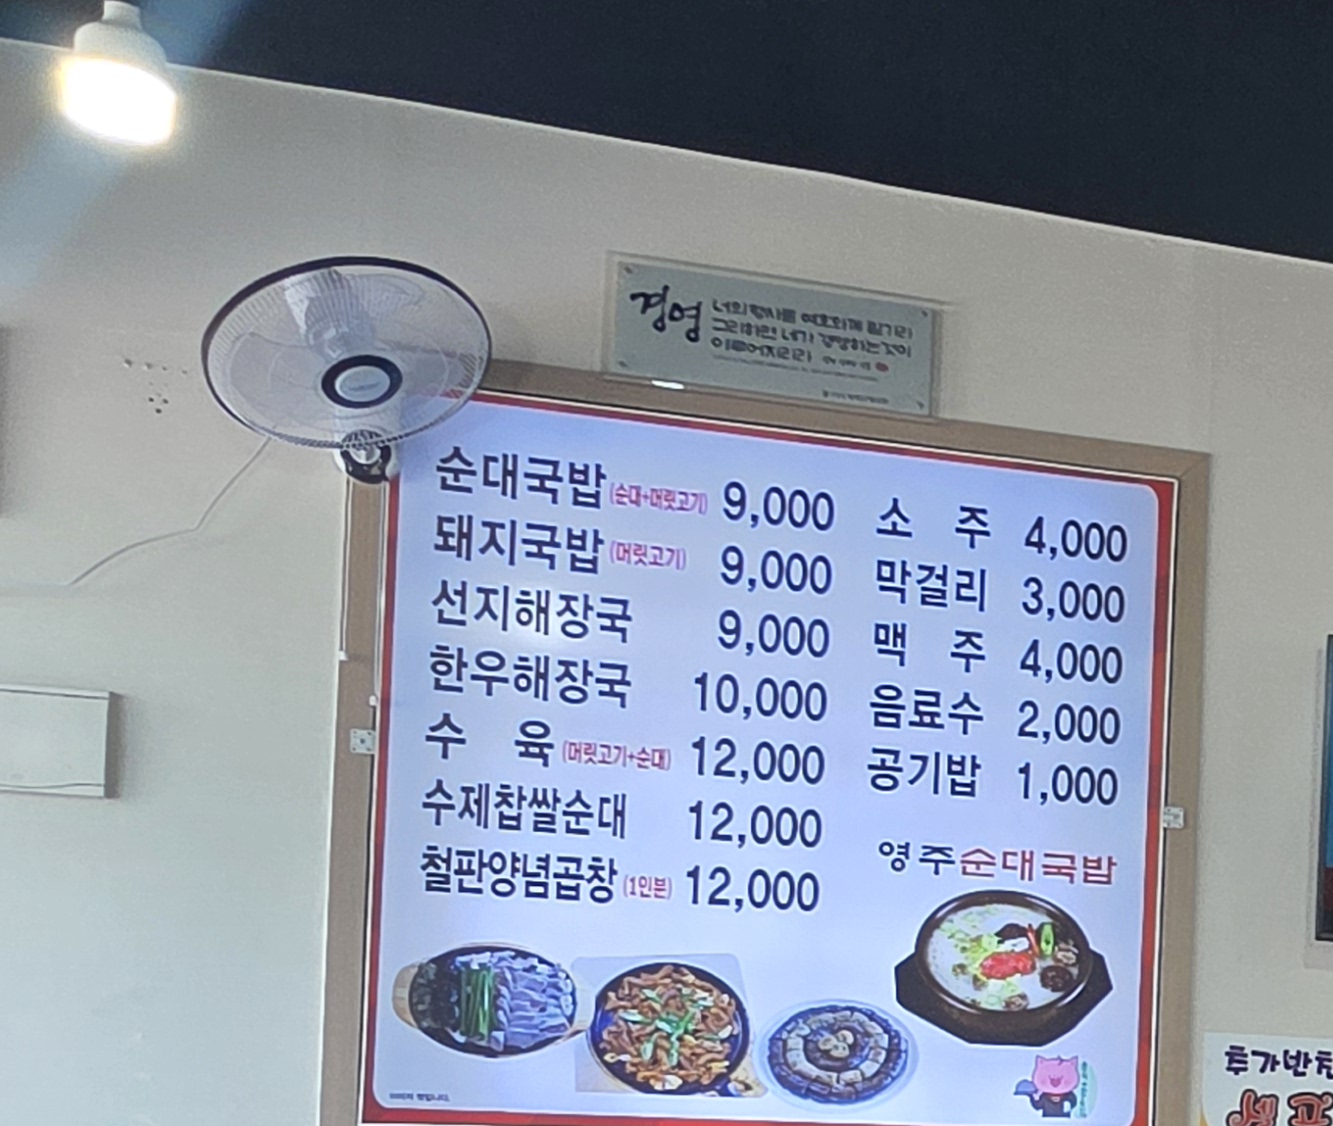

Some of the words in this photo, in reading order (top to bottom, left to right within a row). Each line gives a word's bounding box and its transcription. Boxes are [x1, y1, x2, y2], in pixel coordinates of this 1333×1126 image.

[436, 446, 606, 509] 순대국밥
[722, 481, 835, 531] 9,000
[434, 514, 604, 575] 돼지국밥
[610, 540, 687, 570] (머릿고기)
[720, 545, 832, 595] 9,000
[1024, 516, 1128, 562] 4,000
[431, 579, 633, 643] 선지해장국
[717, 609, 829, 658] 9,000
[876, 560, 987, 613] 막걸리
[1021, 576, 1125, 623] 3,000
[429, 643, 632, 708] 한우해장국
[693, 671, 828, 722] 10,000
[1019, 639, 1123, 684] 4,000
[869, 684, 984, 735] 음료수
[1017, 700, 1121, 745] 2,000
[691, 735, 825, 786] 12,000
[867, 747, 982, 798] 공기밥
[1017, 761, 1119, 806] 1,000
[422, 778, 626, 839] 수제찹쌀순대
[688, 800, 822, 850] 12,000
[420, 845, 618, 904] 철판양념곱창
[623, 874, 672, 899] (1인분)
[685, 865, 820, 915] 12,000
